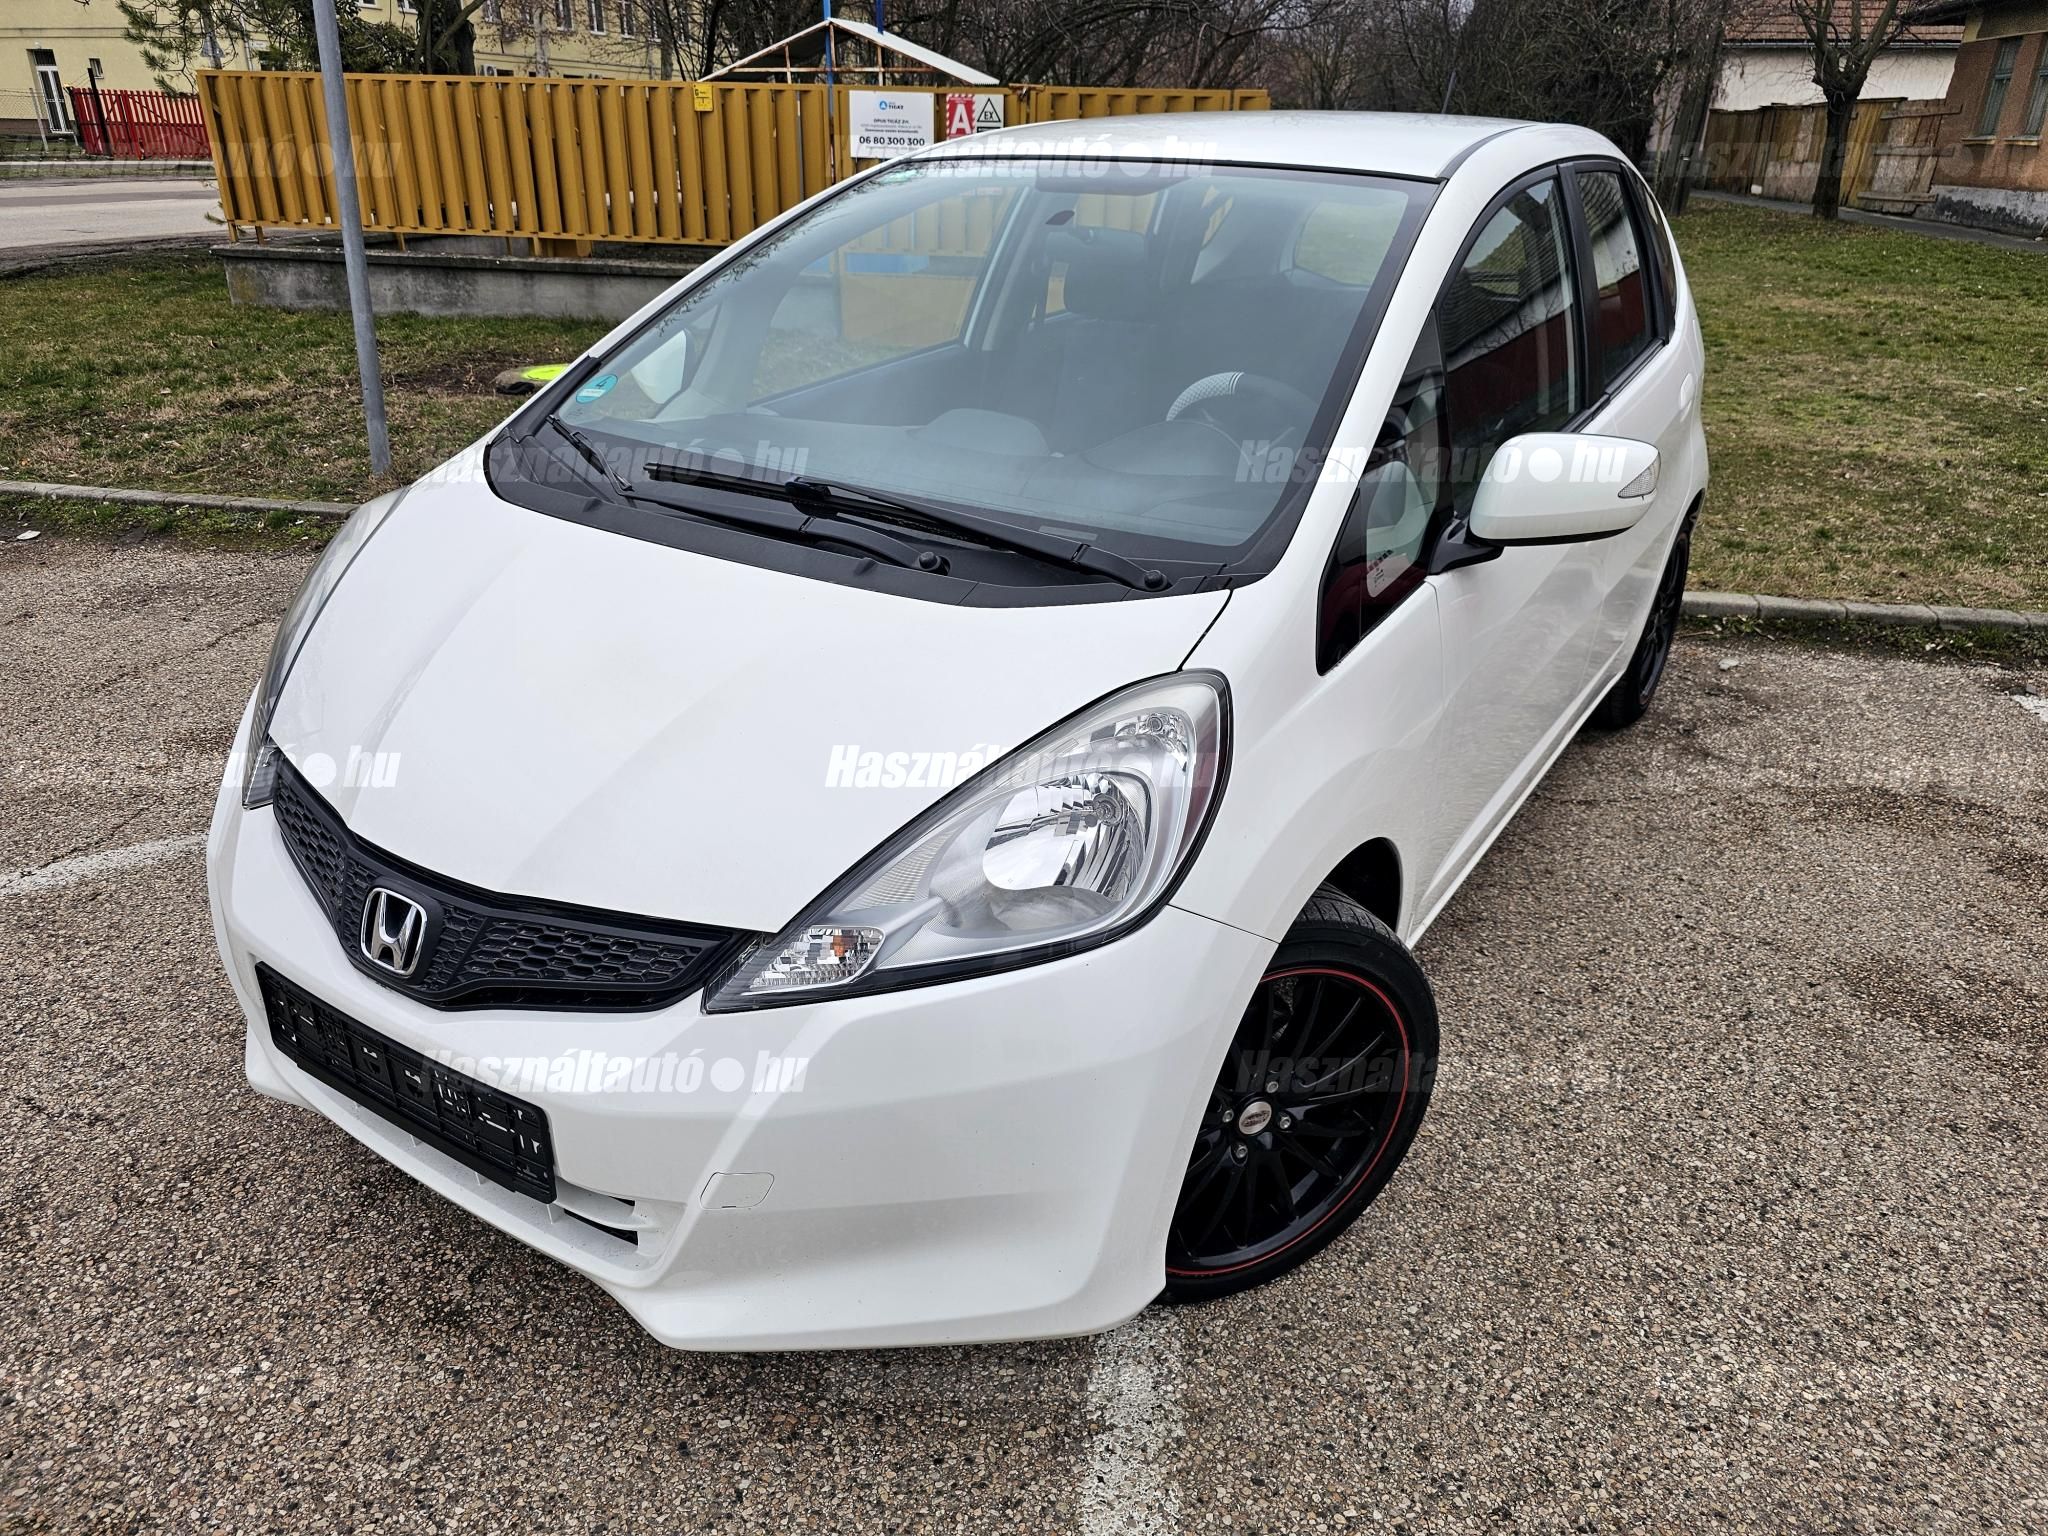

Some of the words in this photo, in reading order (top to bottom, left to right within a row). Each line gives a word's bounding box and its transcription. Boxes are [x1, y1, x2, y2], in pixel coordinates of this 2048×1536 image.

[950, 103, 972, 135] A
[984, 111, 994, 120] EX
[859, 136, 871, 144] 06
[873, 136, 885, 145] 80
[887, 137, 905, 146] 300
[907, 137, 925, 146] 300
[595, 376, 612, 389] 4
